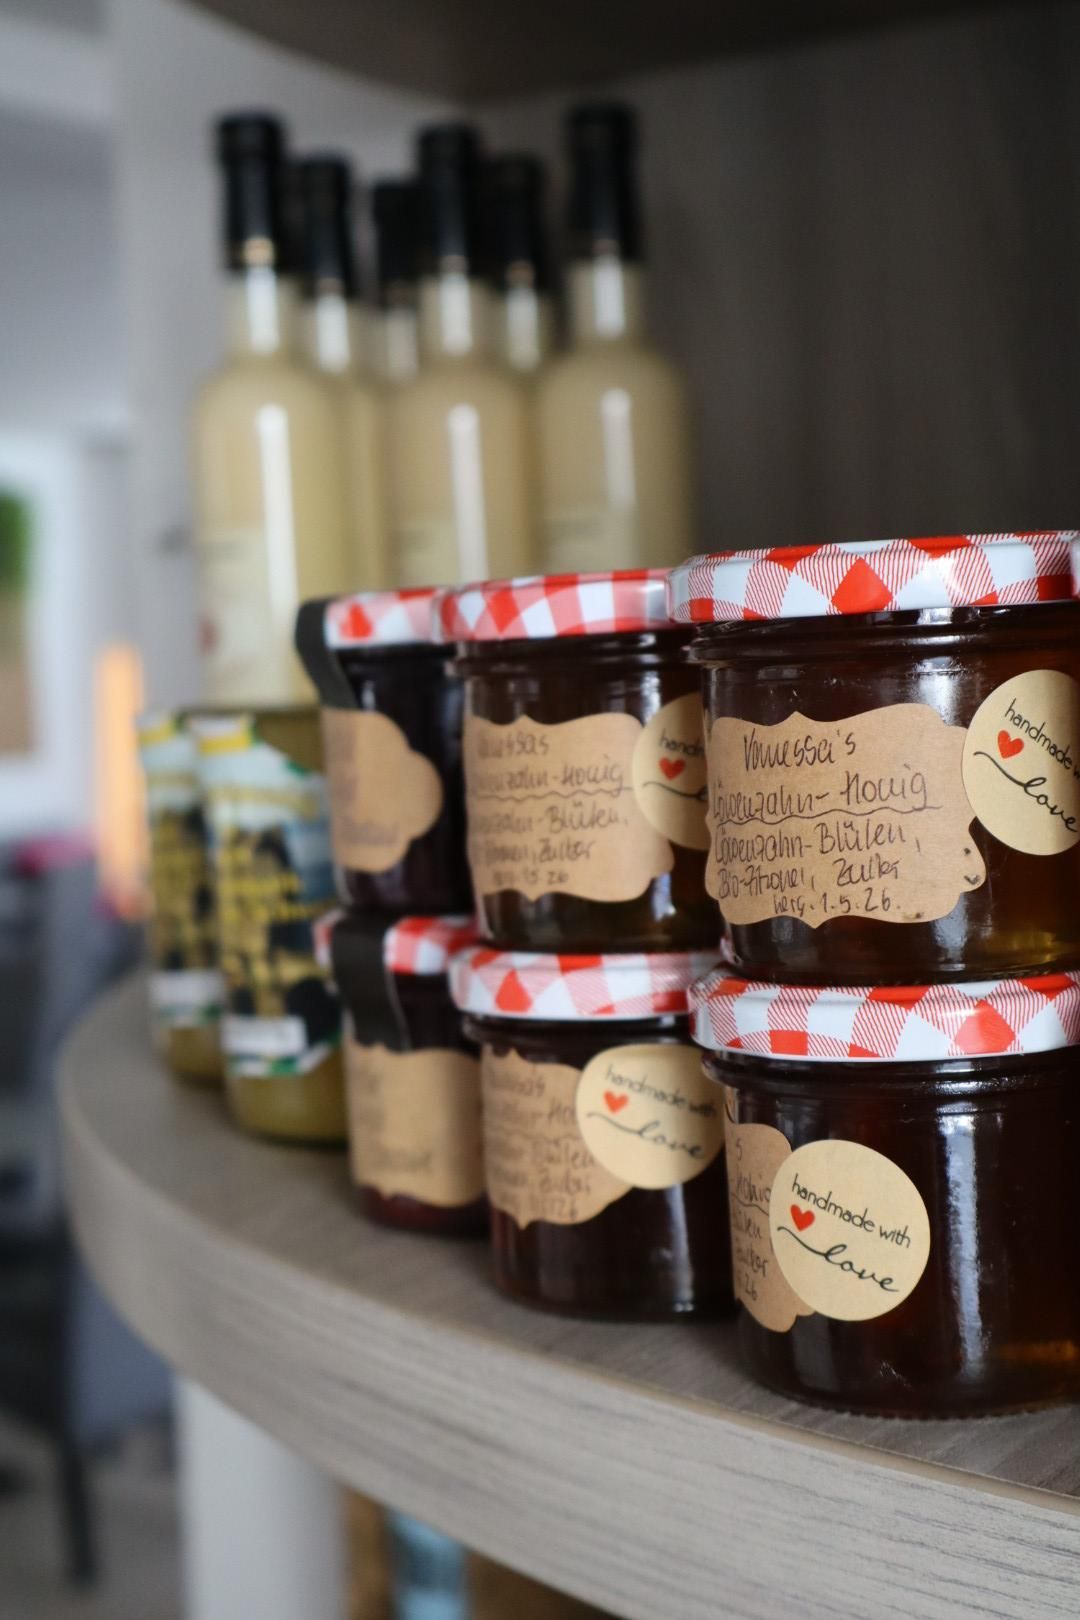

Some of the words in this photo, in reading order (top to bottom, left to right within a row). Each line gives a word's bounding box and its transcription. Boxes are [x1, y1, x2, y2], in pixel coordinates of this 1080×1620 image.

[659, 729, 706, 755] hand
[1004, 698, 1073, 769] handmade
[1024, 776, 1078, 832] love
[604, 1064, 686, 1107] handmade
[637, 1119, 705, 1160] love
[791, 1173, 875, 1232] handmade
[879, 1225, 912, 1249] with
[823, 1243, 900, 1293] love
